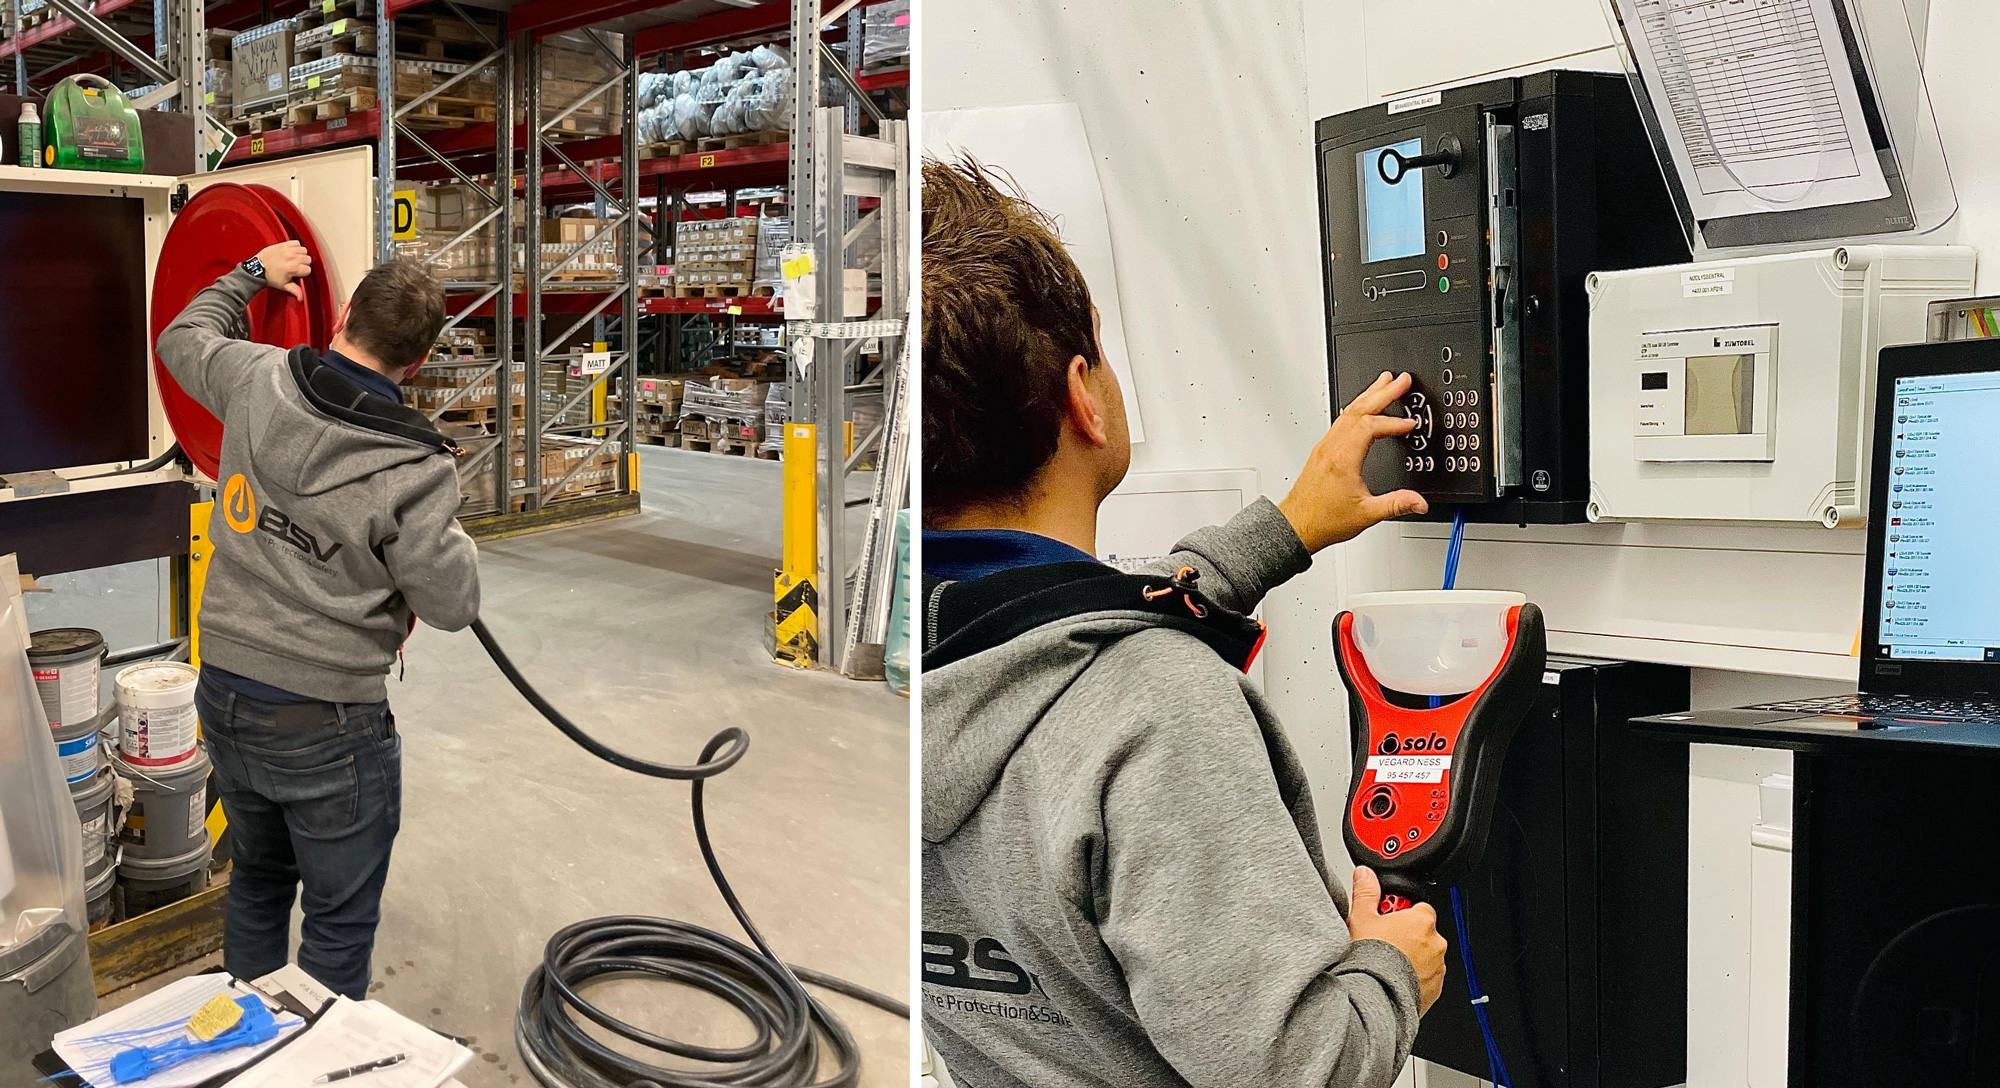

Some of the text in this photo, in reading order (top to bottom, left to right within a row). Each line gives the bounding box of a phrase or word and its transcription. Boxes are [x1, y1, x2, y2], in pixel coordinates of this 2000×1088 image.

[252, 140, 263, 153] D2
[702, 156, 713, 166] F2
[394, 197, 413, 233] D
[1724, 338, 1755, 348] ZUMTOBEL
[587, 359, 606, 368] MATT
[257, 505, 343, 563] BSV
[1403, 732, 1447, 752] solo
[1378, 757, 1441, 767] VEGARD NESS
[1386, 771, 1431, 780] 95 457 457
[922, 930, 1050, 1000] BS
